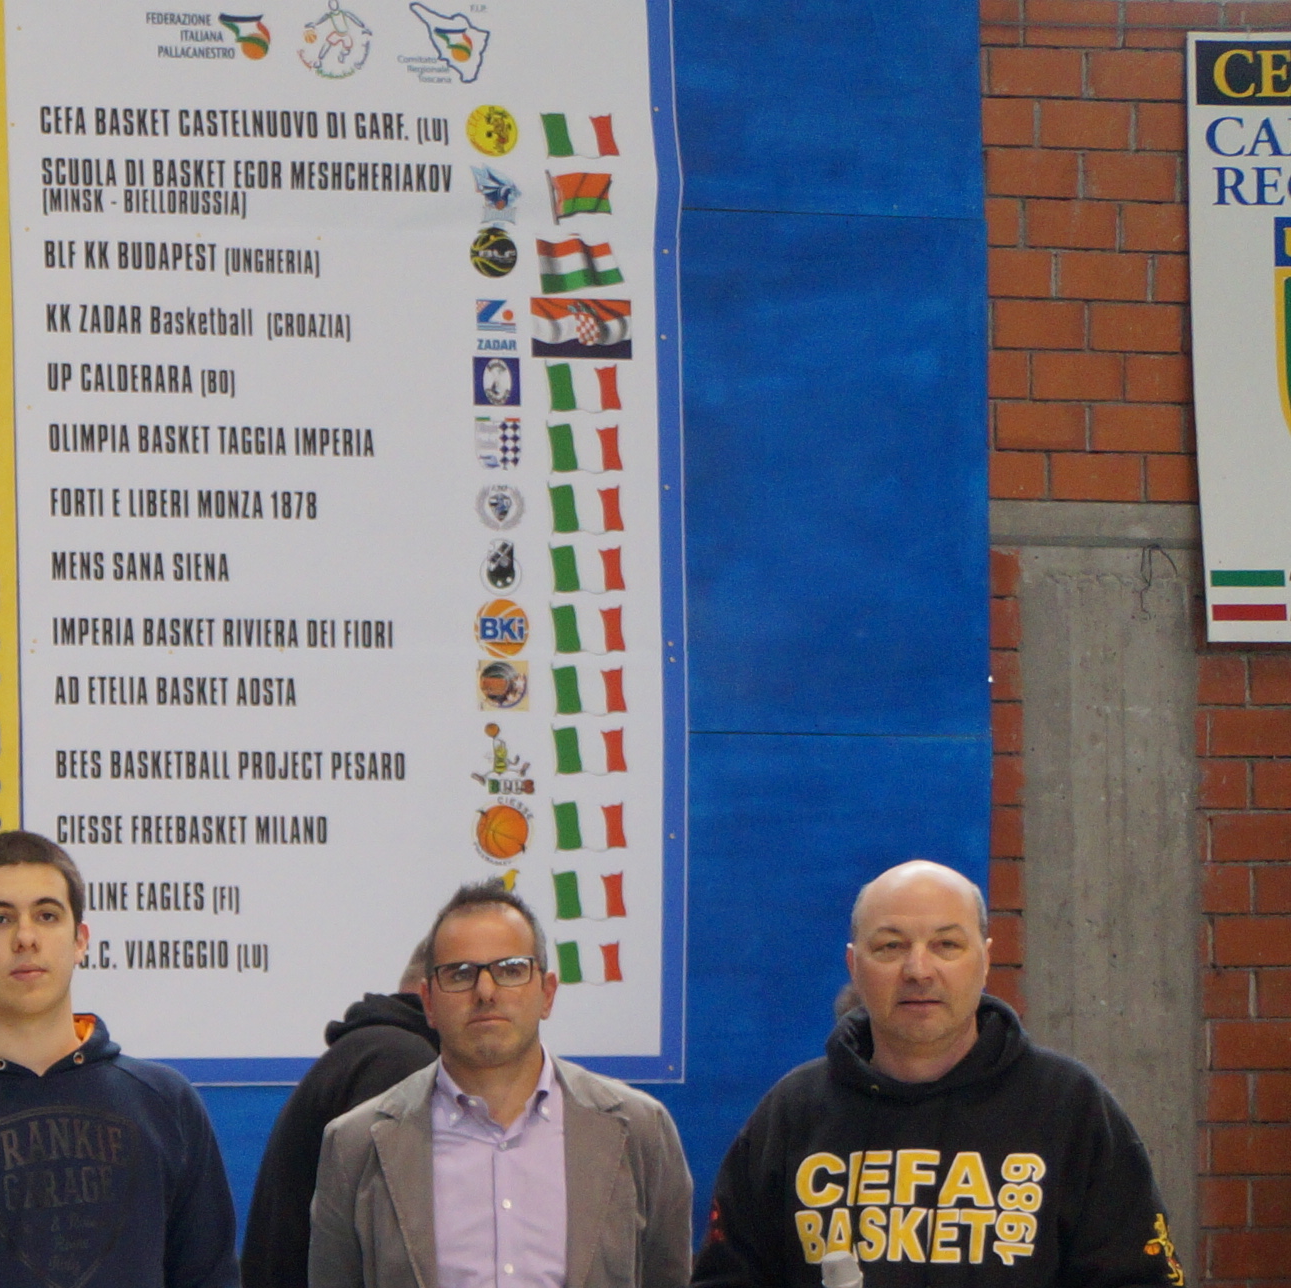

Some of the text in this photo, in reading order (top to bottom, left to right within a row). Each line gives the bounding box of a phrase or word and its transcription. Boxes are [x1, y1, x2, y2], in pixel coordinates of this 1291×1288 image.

[145, 11, 211, 26] FEDERAZIONE
[180, 29, 223, 42] ITALIANA
[157, 45, 235, 60] PALLACANESTRO
[40, 105, 87, 135] CEFA
[95, 107, 170, 137] BASKET
[178, 109, 319, 139] CASTELNUOVO
[326, 111, 347, 140] DI
[354, 112, 409, 141] GARF.
[416, 117, 449, 146] (LU)
[40, 157, 452, 193] SCUOLA DI BASKET EGOR MESHCHERIAKOV
[44, 240, 320, 279] BLF KK BUDAPEST (UNGHERIA)
[46, 303, 351, 343] KK ZADAR Basketball (CROAZIA)
[477, 338, 517, 350] ZADAR
[47, 362, 236, 399] UP CALDERARA (BO)
[48, 423, 375, 457] OLIMPIA BASKET TAGGIA IMPERIA
[50, 487, 317, 520] FORTI E LIBERI MONZA 1878
[51, 551, 229, 582] MENS SANA SIENA
[52, 617, 393, 649] IMPERIA BASKET RIVIERA DEI FIORI
[55, 675, 297, 707] AD ETELIA BASKET AOSTA
[56, 749, 406, 781] BEES BASKETBALL PROJECT PESARO
[55, 814, 328, 845] CIESSE FREEBASKET MILANO
[136, 881, 205, 911] EAGLES
[212, 885, 240, 915] (FI)
[125, 940, 229, 969] VIAREGGIO
[236, 943, 269, 973] (LU)
[795, 1149, 1047, 1266] CEFA 1989
[794, 1207, 998, 1265] BASKET
